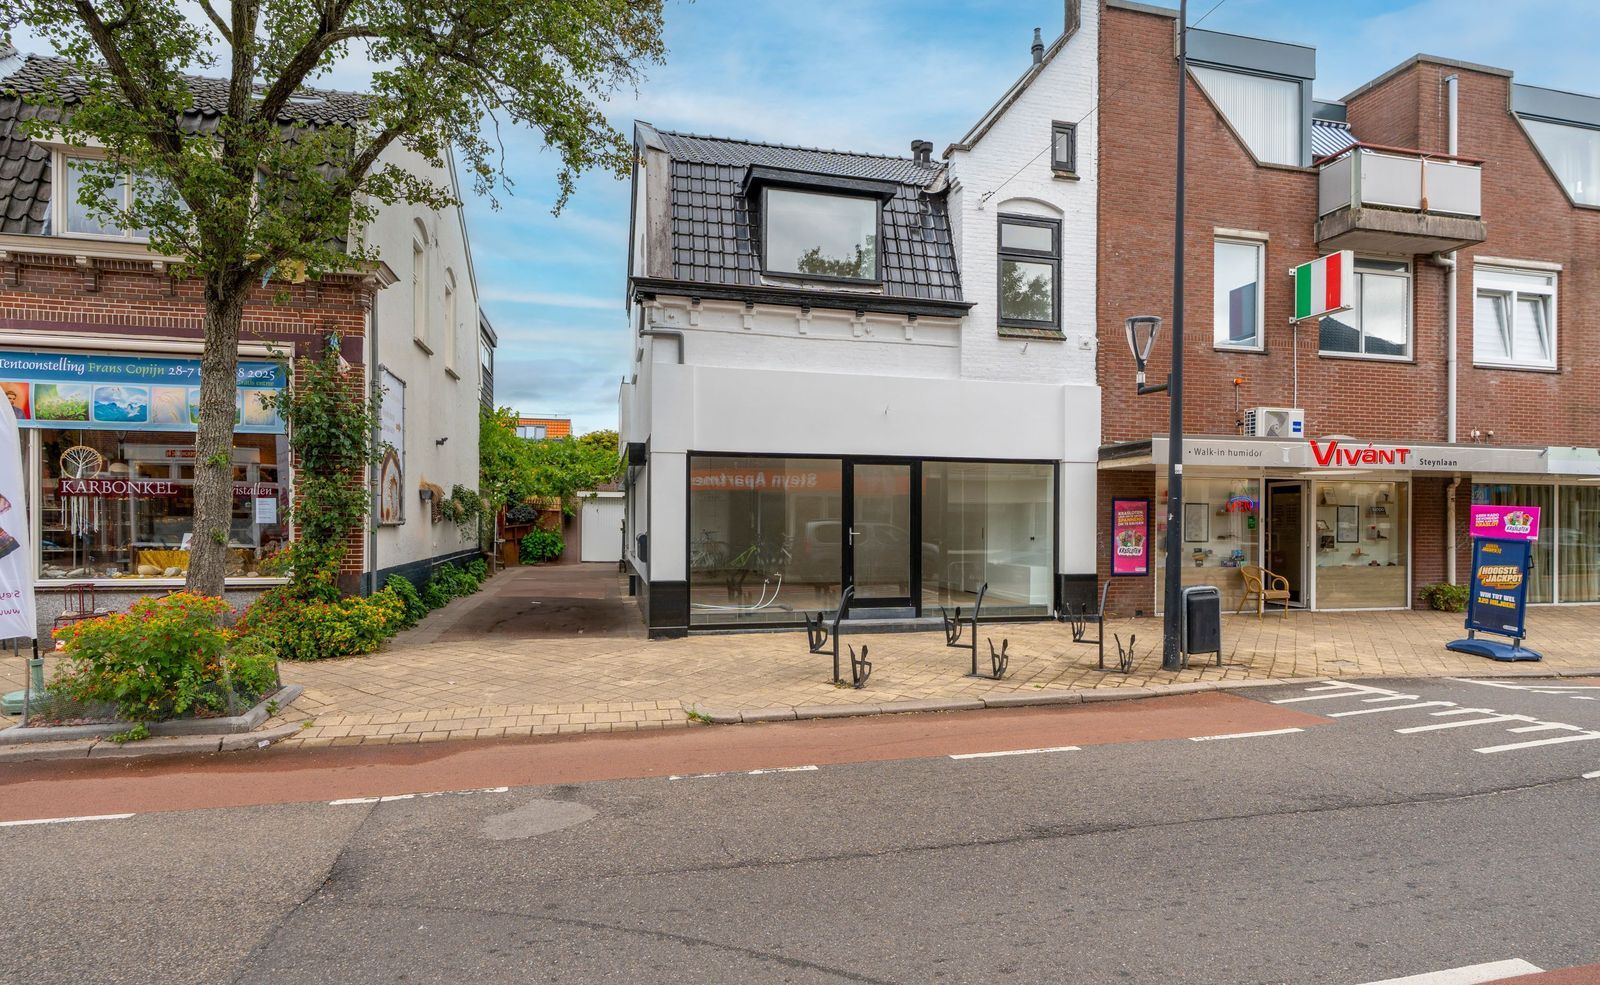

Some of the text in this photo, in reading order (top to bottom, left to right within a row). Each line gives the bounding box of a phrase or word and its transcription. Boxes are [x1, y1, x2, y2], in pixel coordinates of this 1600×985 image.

[88, 362, 122, 373] Frans
[125, 364, 165, 377] Copijn
[168, 365, 195, 378] 28-7
[247, 370, 275, 380] 2025
[1193, 448, 1263, 457] Walk-in humidor
[1419, 458, 1458, 468] Steynlaan
[61, 480, 178, 495] KARBONKEL
[231, 482, 272, 496] ristallen
[1481, 566, 1518, 575] HOOGSTE
[1486, 574, 1523, 583] JACKPOT
